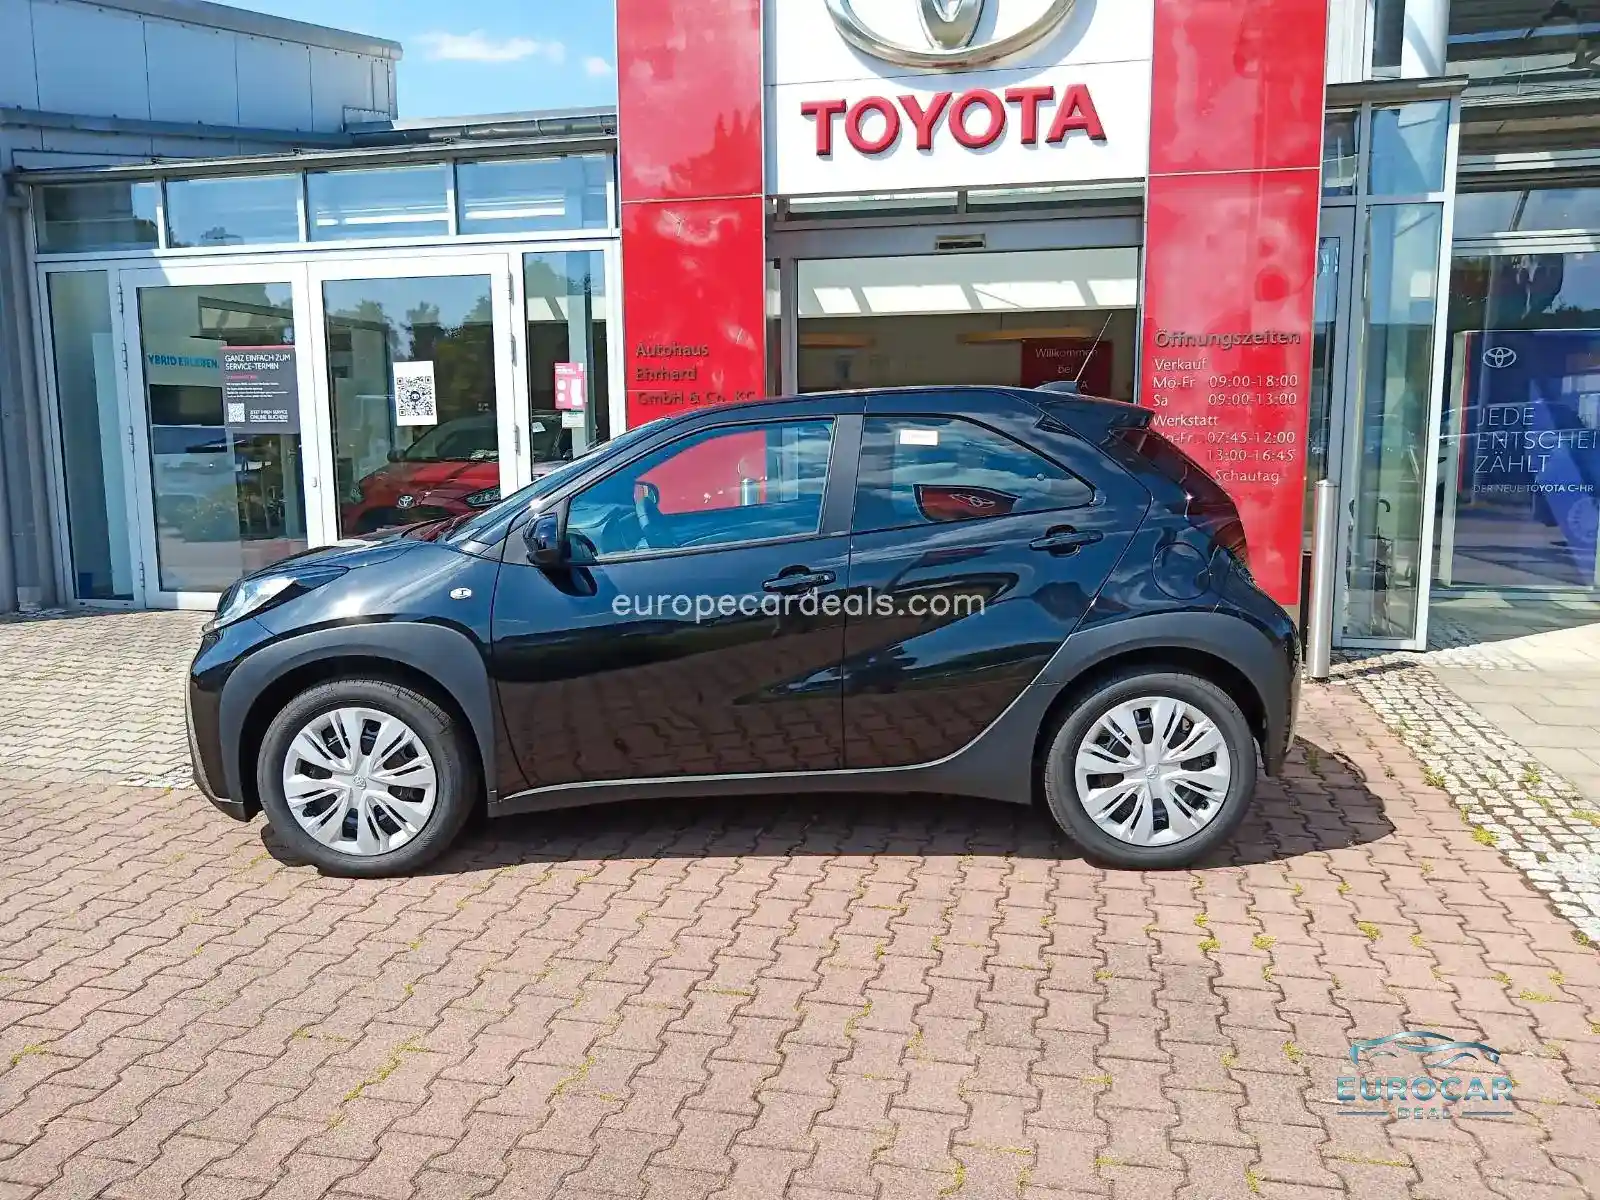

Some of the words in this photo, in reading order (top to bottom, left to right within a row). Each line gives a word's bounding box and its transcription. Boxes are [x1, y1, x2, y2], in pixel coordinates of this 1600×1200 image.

[801, 84, 1106, 155] TOYOTA
[1154, 329, 1301, 350] Öffnungszeiten
[636, 342, 709, 357] Autohaus
[224, 354, 244, 362] GANZ
[245, 354, 275, 362] EINFACH
[275, 353, 291, 361] ZUM
[1154, 358, 1206, 371] Verkauf
[636, 366, 697, 381] Ehrhard
[1153, 376, 1195, 389] Mo-Fr
[1209, 375, 1298, 388] 09:00-18:00
[638, 391, 684, 406] GmbH
[690, 391, 700, 404] &
[1153, 395, 1168, 407] Sa
[1208, 393, 1297, 406] 09:00-13:00
[1153, 415, 1218, 427] Werkstatt
[1477, 407, 1535, 426] JEDE
[1161, 431, 1193, 443] o-Fr
[1207, 431, 1296, 444] 07:45-12:00
[1477, 430, 1597, 450] ENTSCHEI
[1207, 449, 1296, 461] 13:00-16:45
[1475, 451, 1551, 473] ZÄHLT
[1215, 469, 1280, 485] Schautag
[1474, 484, 1494, 493] DER
[1495, 484, 1524, 493] NEUE
[1527, 484, 1565, 493] TOYOTA
[1567, 484, 1594, 493] C-HR
